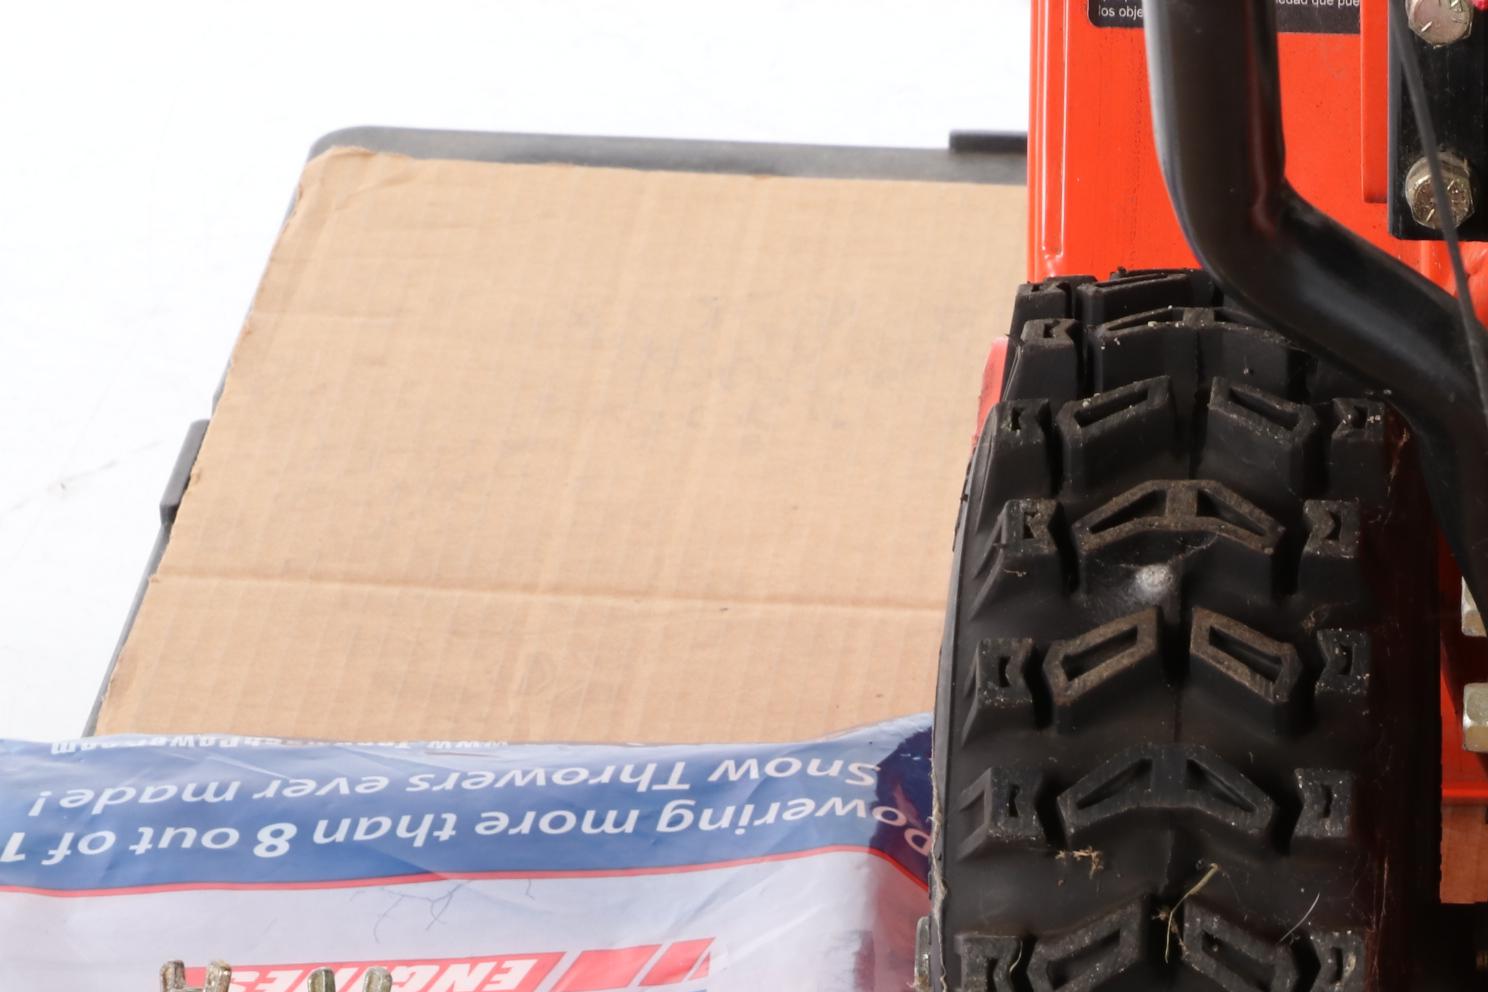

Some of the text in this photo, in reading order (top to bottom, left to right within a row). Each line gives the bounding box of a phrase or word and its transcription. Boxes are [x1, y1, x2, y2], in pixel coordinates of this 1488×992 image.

[1098, 4, 1115, 17] los
[27, 757, 881, 816] Snow Throwers ever made!
[312, 812, 457, 848] than
[474, 808, 640, 835] more
[41, 829, 116, 866] of
[129, 825, 240, 855] out
[253, 821, 298, 859] 8
